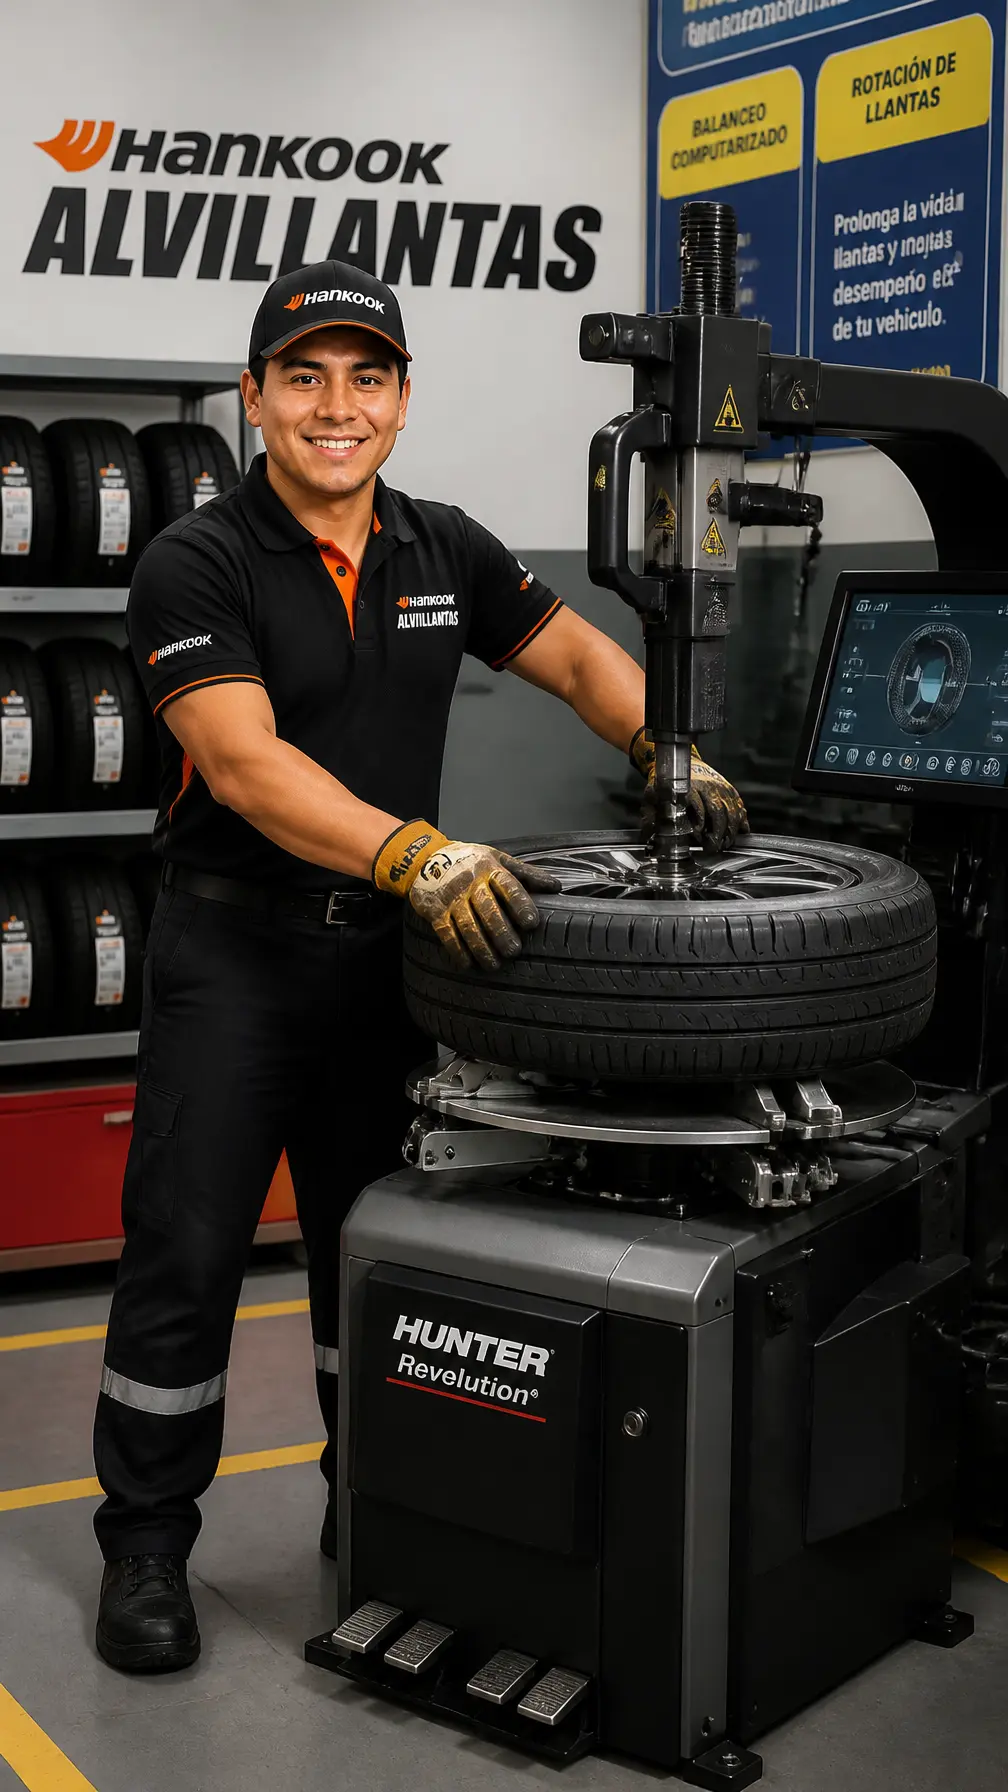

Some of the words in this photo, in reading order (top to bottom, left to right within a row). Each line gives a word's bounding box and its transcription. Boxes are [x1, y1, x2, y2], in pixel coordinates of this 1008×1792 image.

[852, 55, 932, 98] ROTACIÓN
[935, 51, 957, 77] DE
[692, 102, 767, 138] BALANCEO
[866, 86, 941, 124] LLANTAS
[671, 124, 788, 170] COMPUTARIZADO
[834, 207, 900, 236] Prolonga
[902, 199, 918, 223] la
[22, 186, 603, 292] ALVILLANTAS
[833, 241, 886, 270] llantas
[887, 239, 899, 267] y
[832, 316, 853, 341] de
[855, 315, 873, 338] tu
